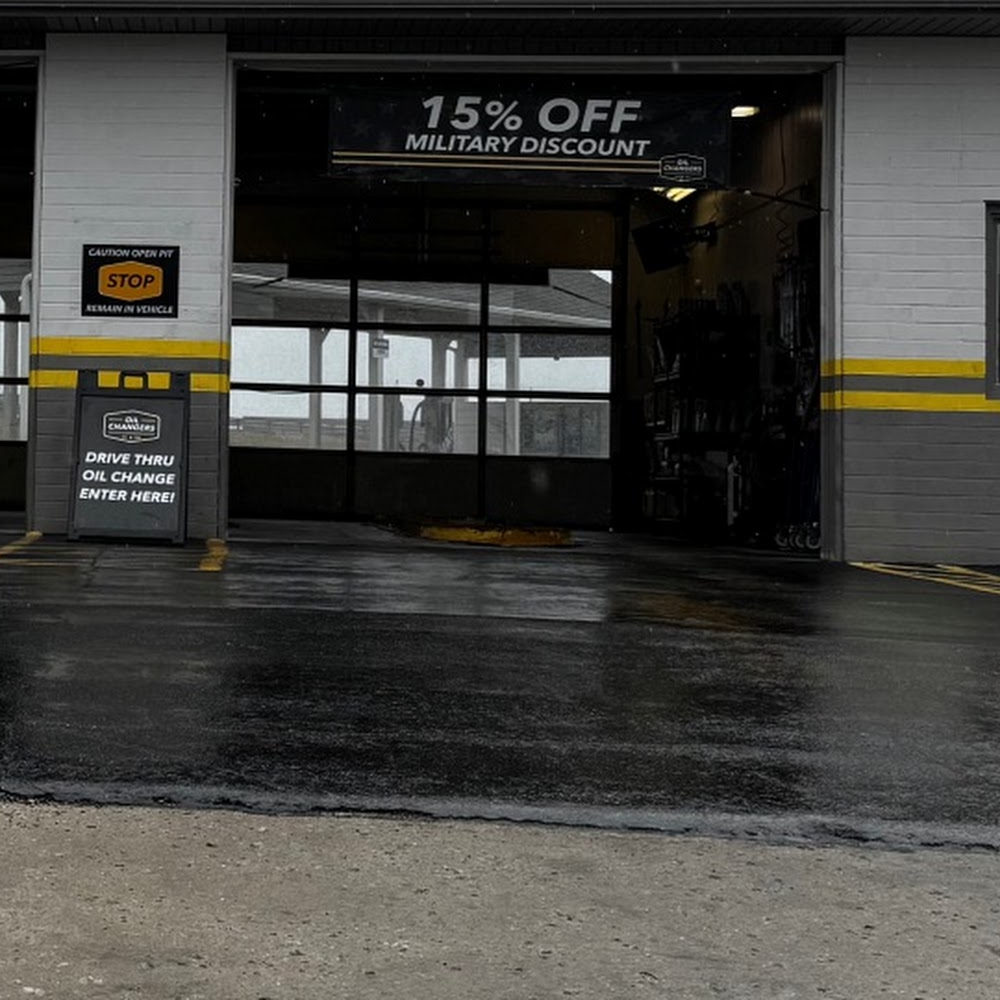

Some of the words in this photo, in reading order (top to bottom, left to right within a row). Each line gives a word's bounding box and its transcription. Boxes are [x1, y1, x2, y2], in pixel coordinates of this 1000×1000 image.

[422, 95, 523, 132] 15%
[538, 97, 642, 134] OFF
[405, 133, 518, 153] MILITARY
[520, 136, 650, 157] DISCOUNT
[88, 248, 129, 258] CAUTION
[131, 249, 158, 259] OPEN
[159, 250, 174, 259] PIT
[107, 274, 155, 288] STOP
[86, 304, 123, 313] REMAIN
[124, 305, 134, 313] IN
[136, 305, 173, 314] VEHICLE
[85, 451, 131, 465] DRIVE
[134, 454, 175, 467] THRU
[82, 470, 107, 482] OIL
[110, 471, 176, 485] CHANGE
[79, 488, 127, 501] ENTER
[130, 490, 175, 503] HERE!
